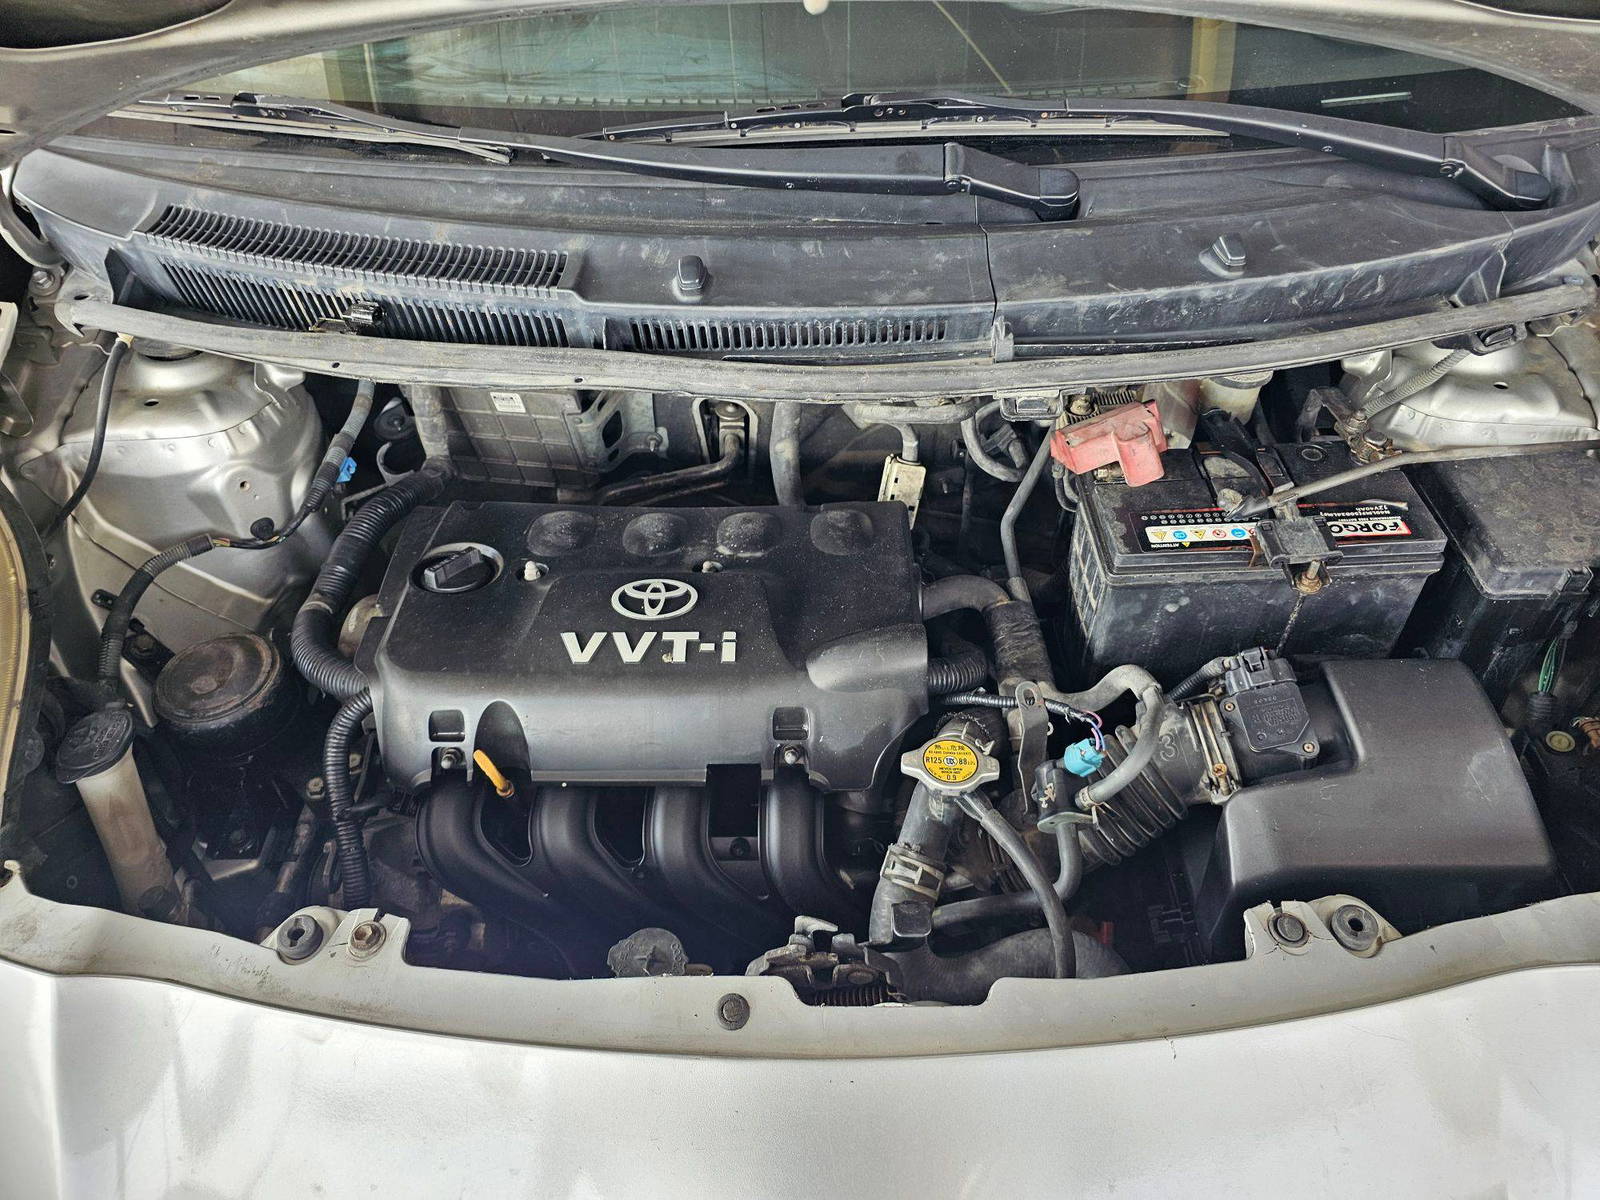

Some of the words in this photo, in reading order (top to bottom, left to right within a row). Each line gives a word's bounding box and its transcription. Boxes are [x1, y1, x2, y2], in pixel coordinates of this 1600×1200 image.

[1330, 522, 1399, 534] FORGO
[560, 631, 737, 664] VVT-i
[1159, 733, 1178, 762] 3
[925, 756, 942, 764] R125
